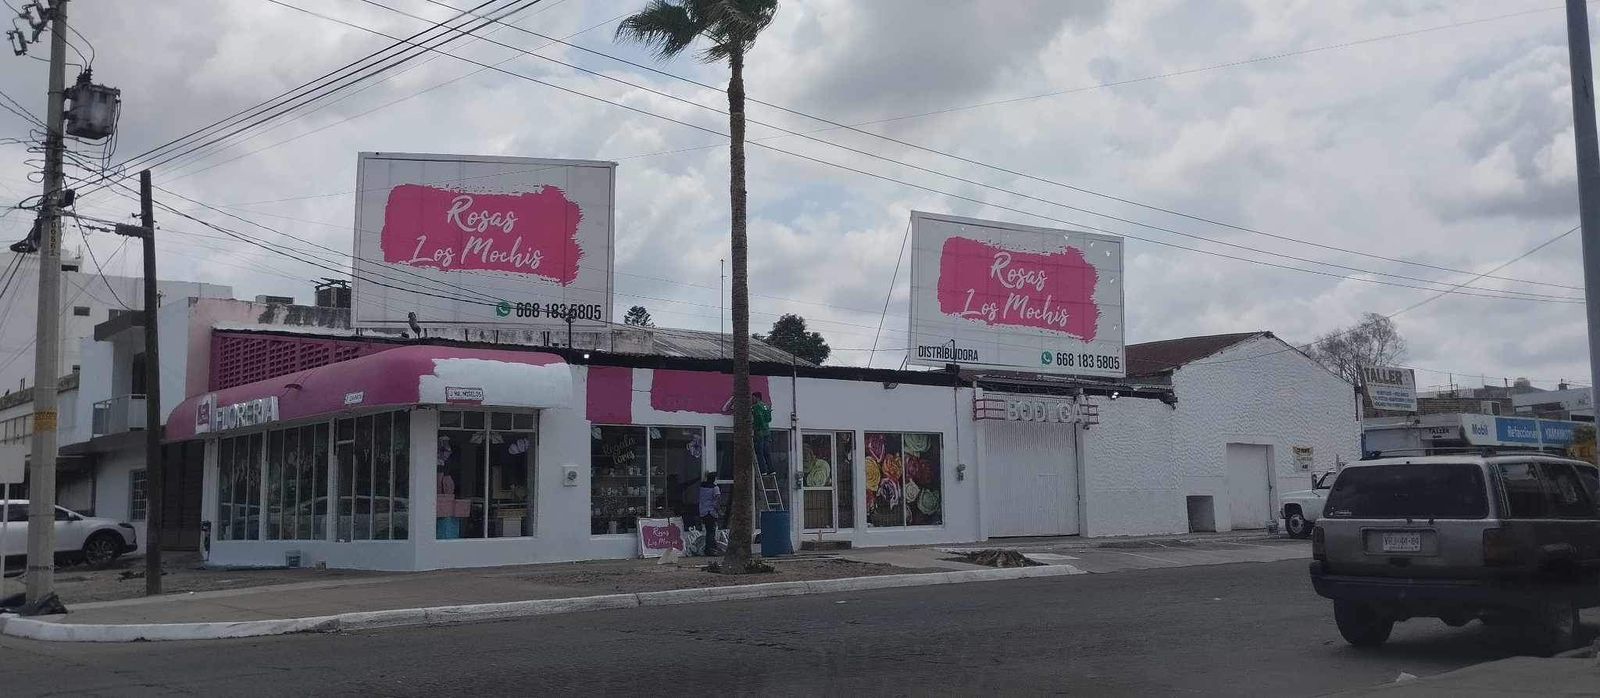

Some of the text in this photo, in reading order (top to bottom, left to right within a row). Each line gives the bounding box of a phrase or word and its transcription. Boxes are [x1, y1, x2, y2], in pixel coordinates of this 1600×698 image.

[447, 195, 518, 232] Rosas
[410, 235, 544, 270] Los Mochis
[991, 251, 1048, 291] Rosas
[516, 302, 601, 320] 668 183 5805
[961, 288, 1069, 326] Los Mochis
[918, 345, 979, 361] DISTRIBUIDORA
[1056, 352, 1120, 369] 668 183 5805
[1363, 367, 1403, 385] TALLER
[1471, 423, 1488, 436] Mobil
